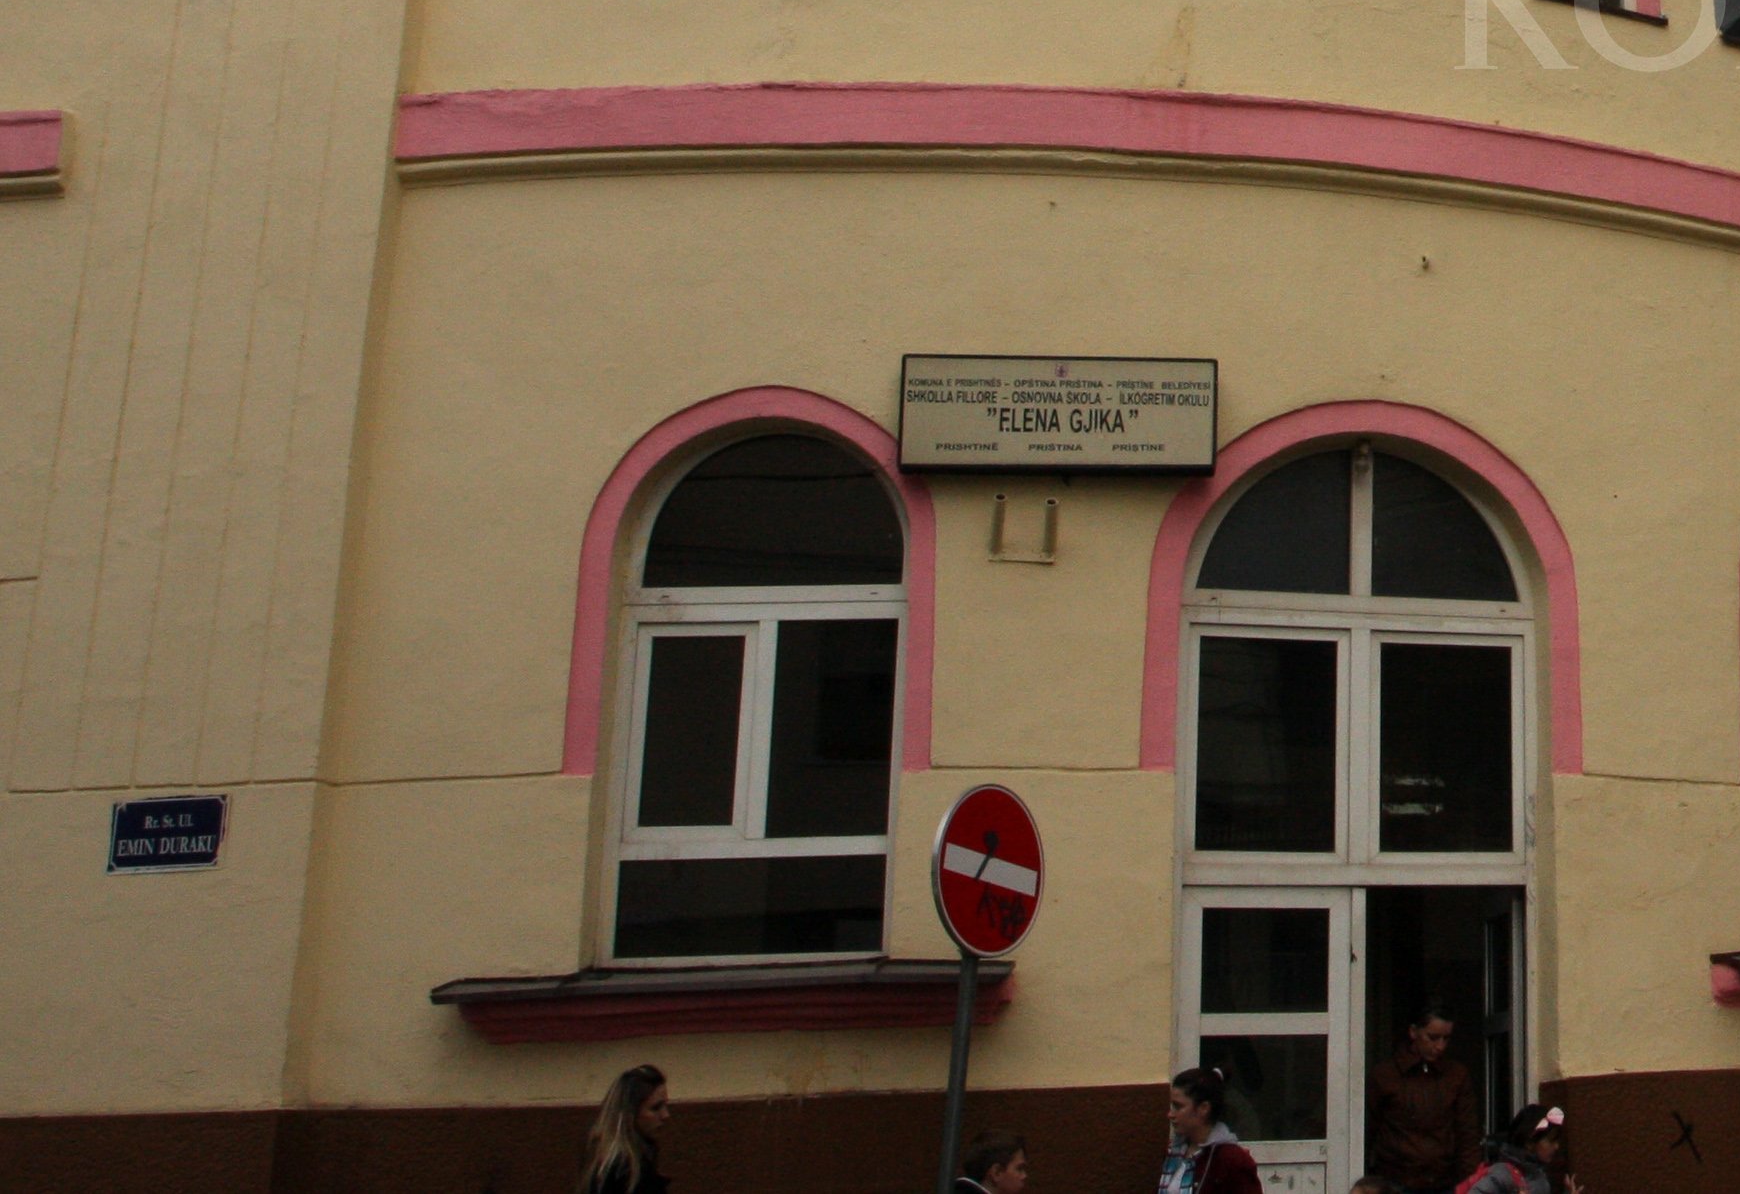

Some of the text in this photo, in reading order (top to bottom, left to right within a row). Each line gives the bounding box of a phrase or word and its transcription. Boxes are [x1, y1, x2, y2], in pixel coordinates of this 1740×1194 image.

[906, 390, 953, 403] SHKOLLA
[956, 390, 998, 404] FILLORE
[1011, 390, 1064, 404] OSNOVNA
[1177, 393, 1210, 407] OKULU
[116, 834, 217, 856] EMIN DURAKU
